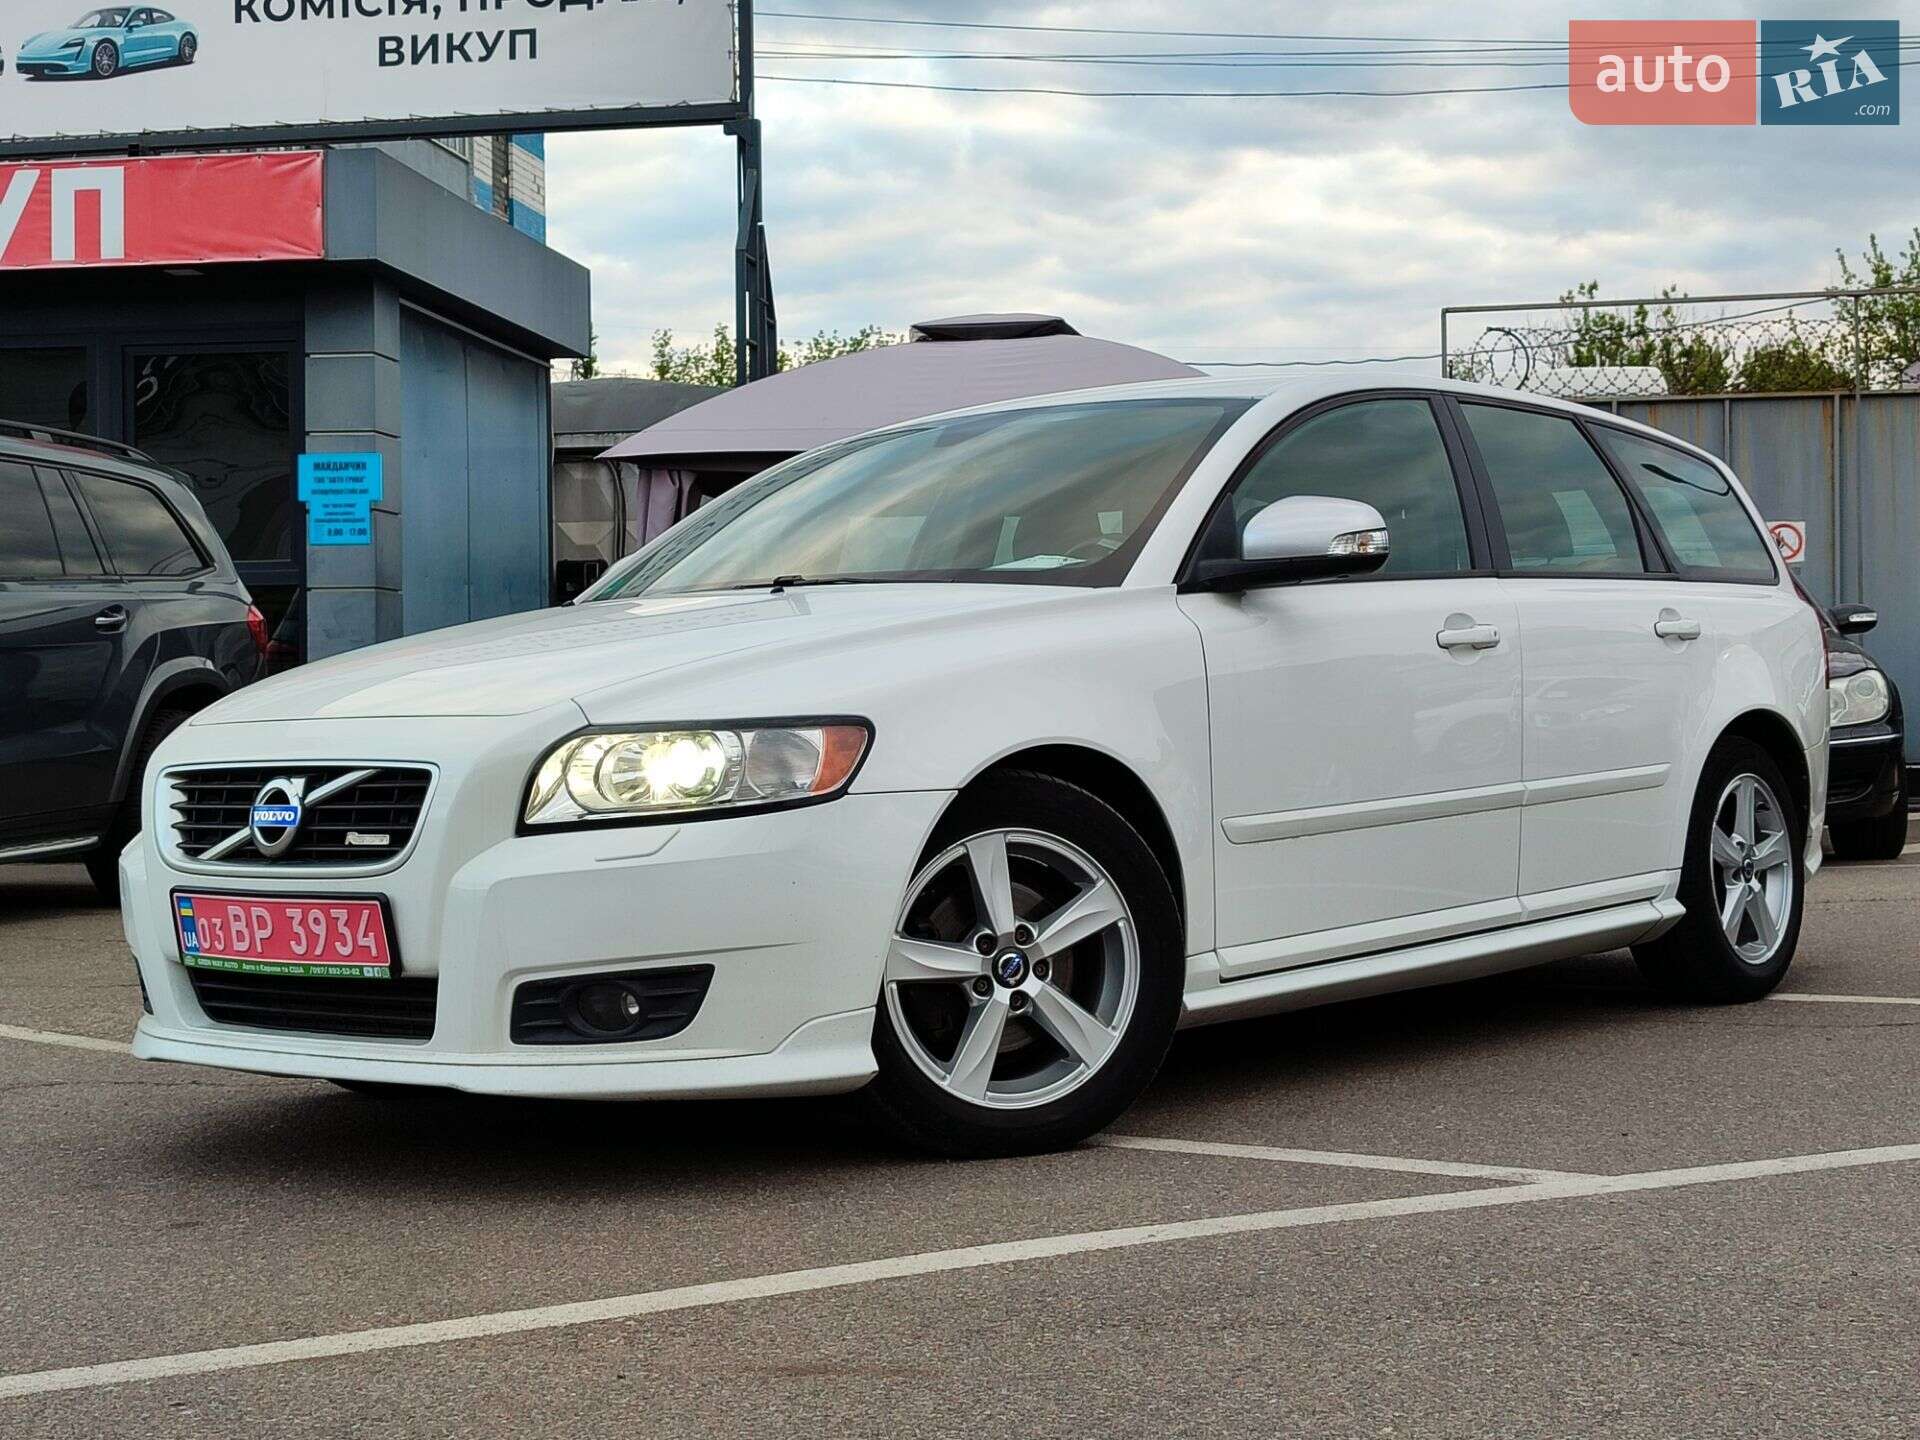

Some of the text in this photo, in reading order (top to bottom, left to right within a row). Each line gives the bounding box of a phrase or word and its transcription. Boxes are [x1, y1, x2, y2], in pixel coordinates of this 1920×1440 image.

[378, 28, 537, 67] ВИКУП
[253, 810, 296, 822] VOLVO
[183, 931, 200, 948] UA
[199, 917, 225, 951] 03
[285, 907, 379, 958] 3934
